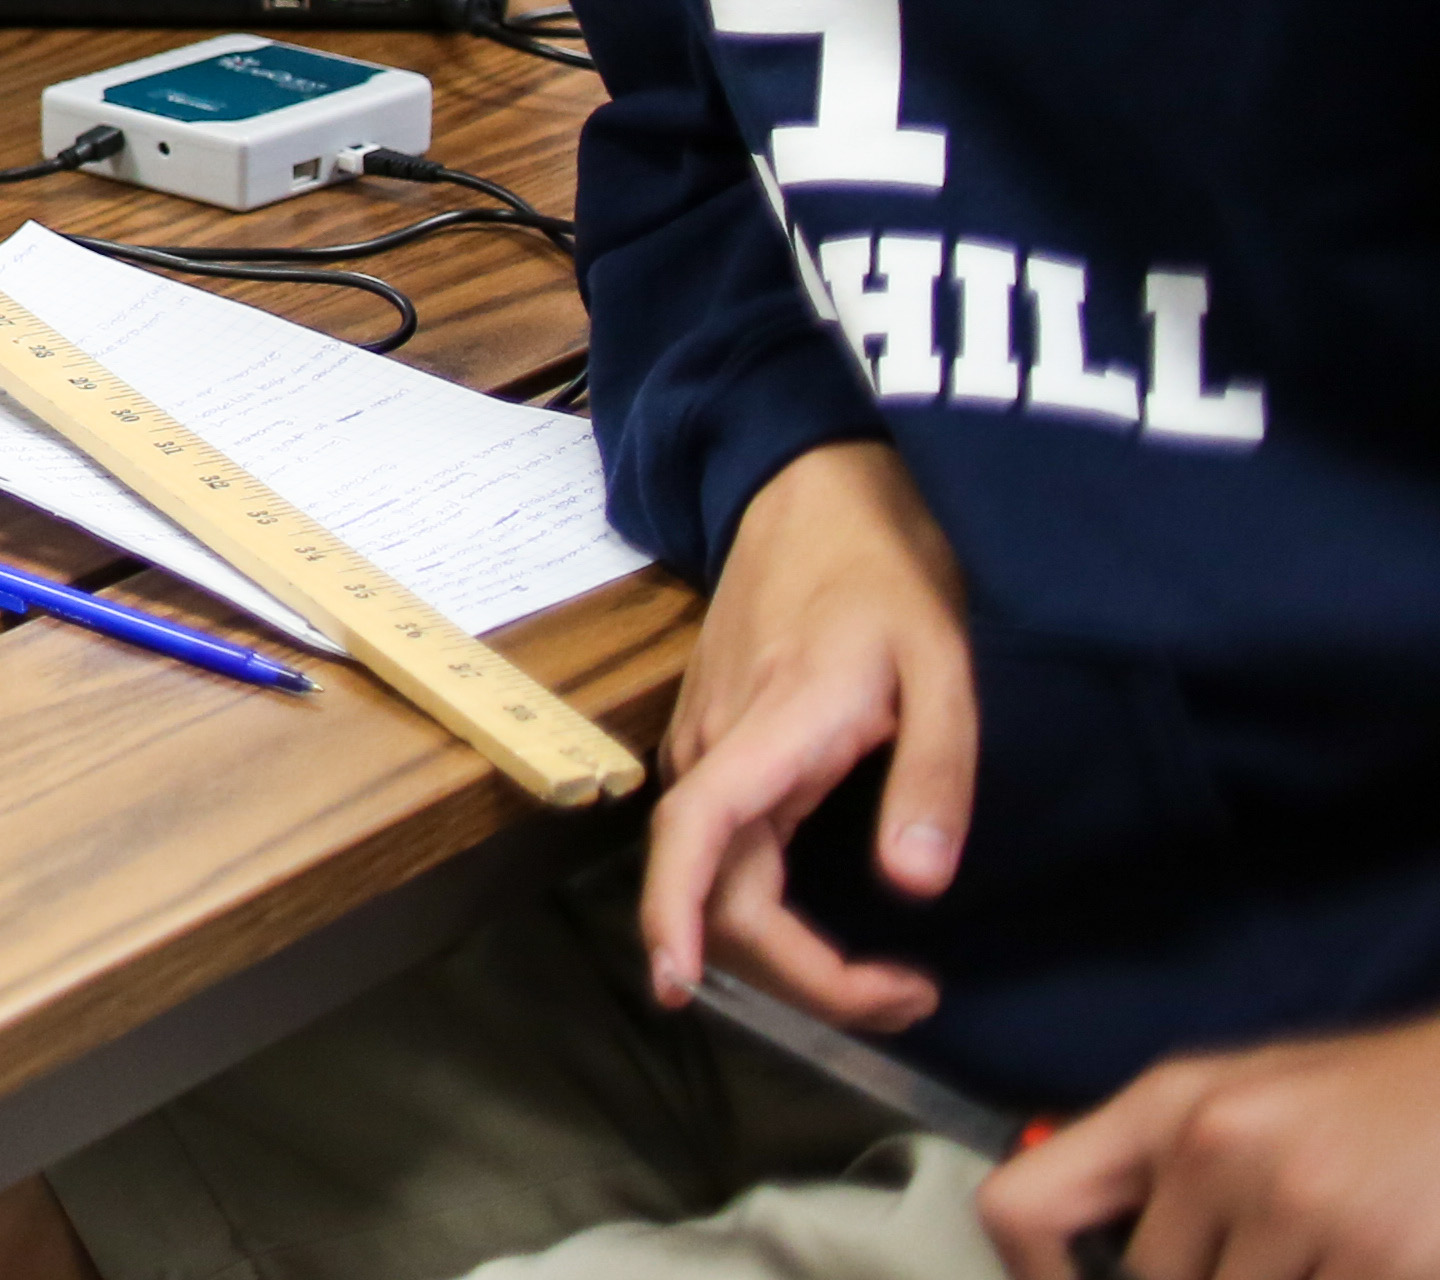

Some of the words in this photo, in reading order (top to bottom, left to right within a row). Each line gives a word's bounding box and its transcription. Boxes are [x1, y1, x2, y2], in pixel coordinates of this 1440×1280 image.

[819, 234, 1266, 448] HILL
[29, 344, 56, 359] 28
[68, 376, 98, 391] 29
[111, 408, 141, 423] 30
[154, 440, 184, 456] 31
[200, 475, 230, 490] 32
[247, 510, 278, 525] 33
[294, 546, 327, 561] 34
[344, 583, 378, 599] 35
